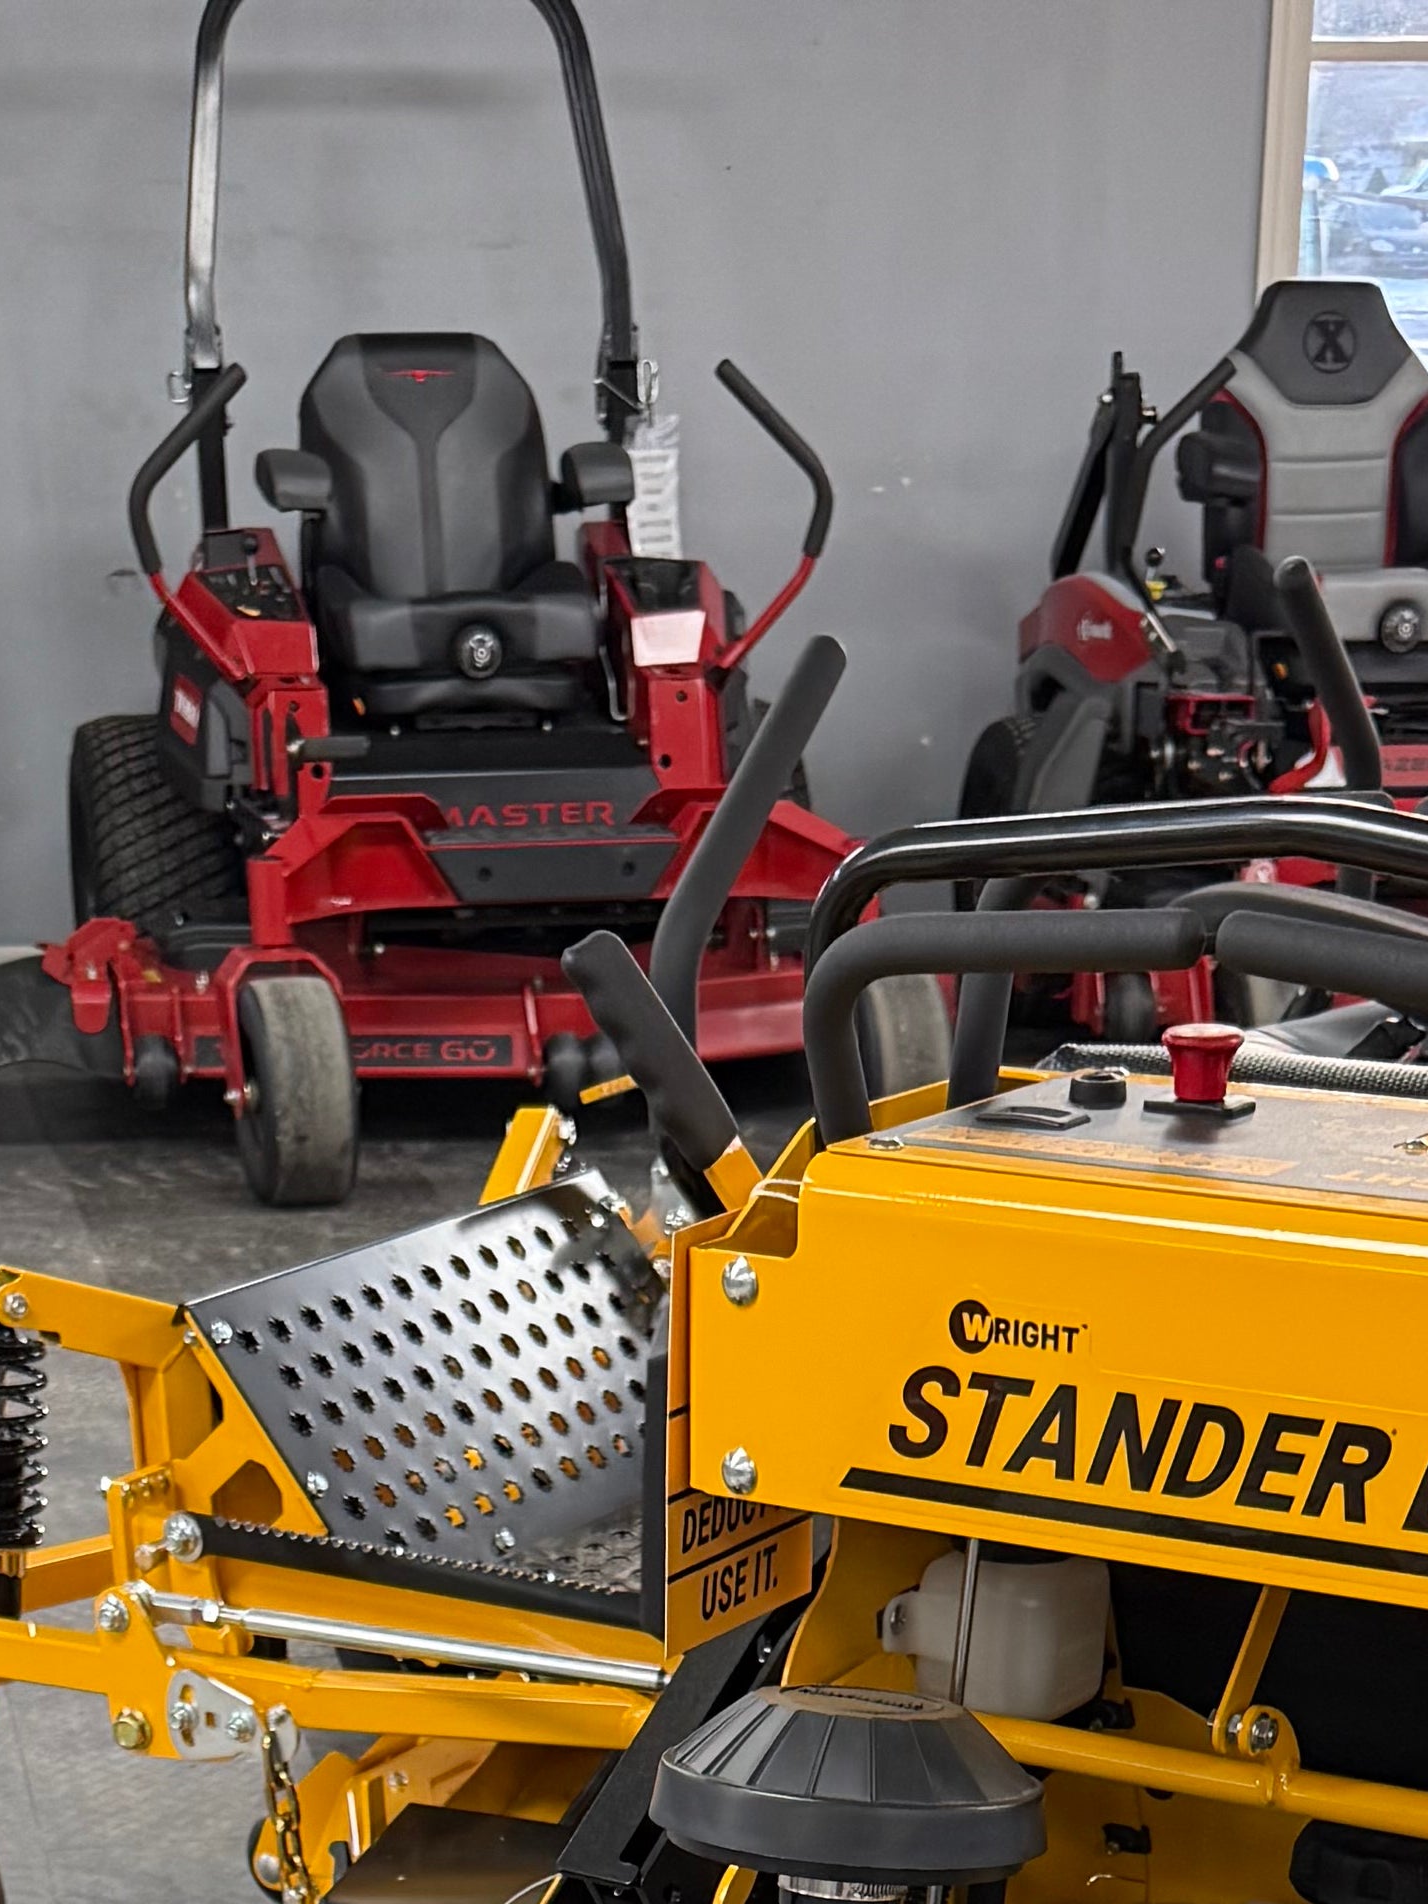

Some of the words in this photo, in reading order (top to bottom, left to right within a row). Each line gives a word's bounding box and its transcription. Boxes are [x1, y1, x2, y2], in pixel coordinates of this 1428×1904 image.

[440, 1040, 496, 1062] 60
[889, 1365, 1394, 1526] STANDER
[701, 1557, 749, 1621] USE
[753, 1543, 778, 1598] IT.
